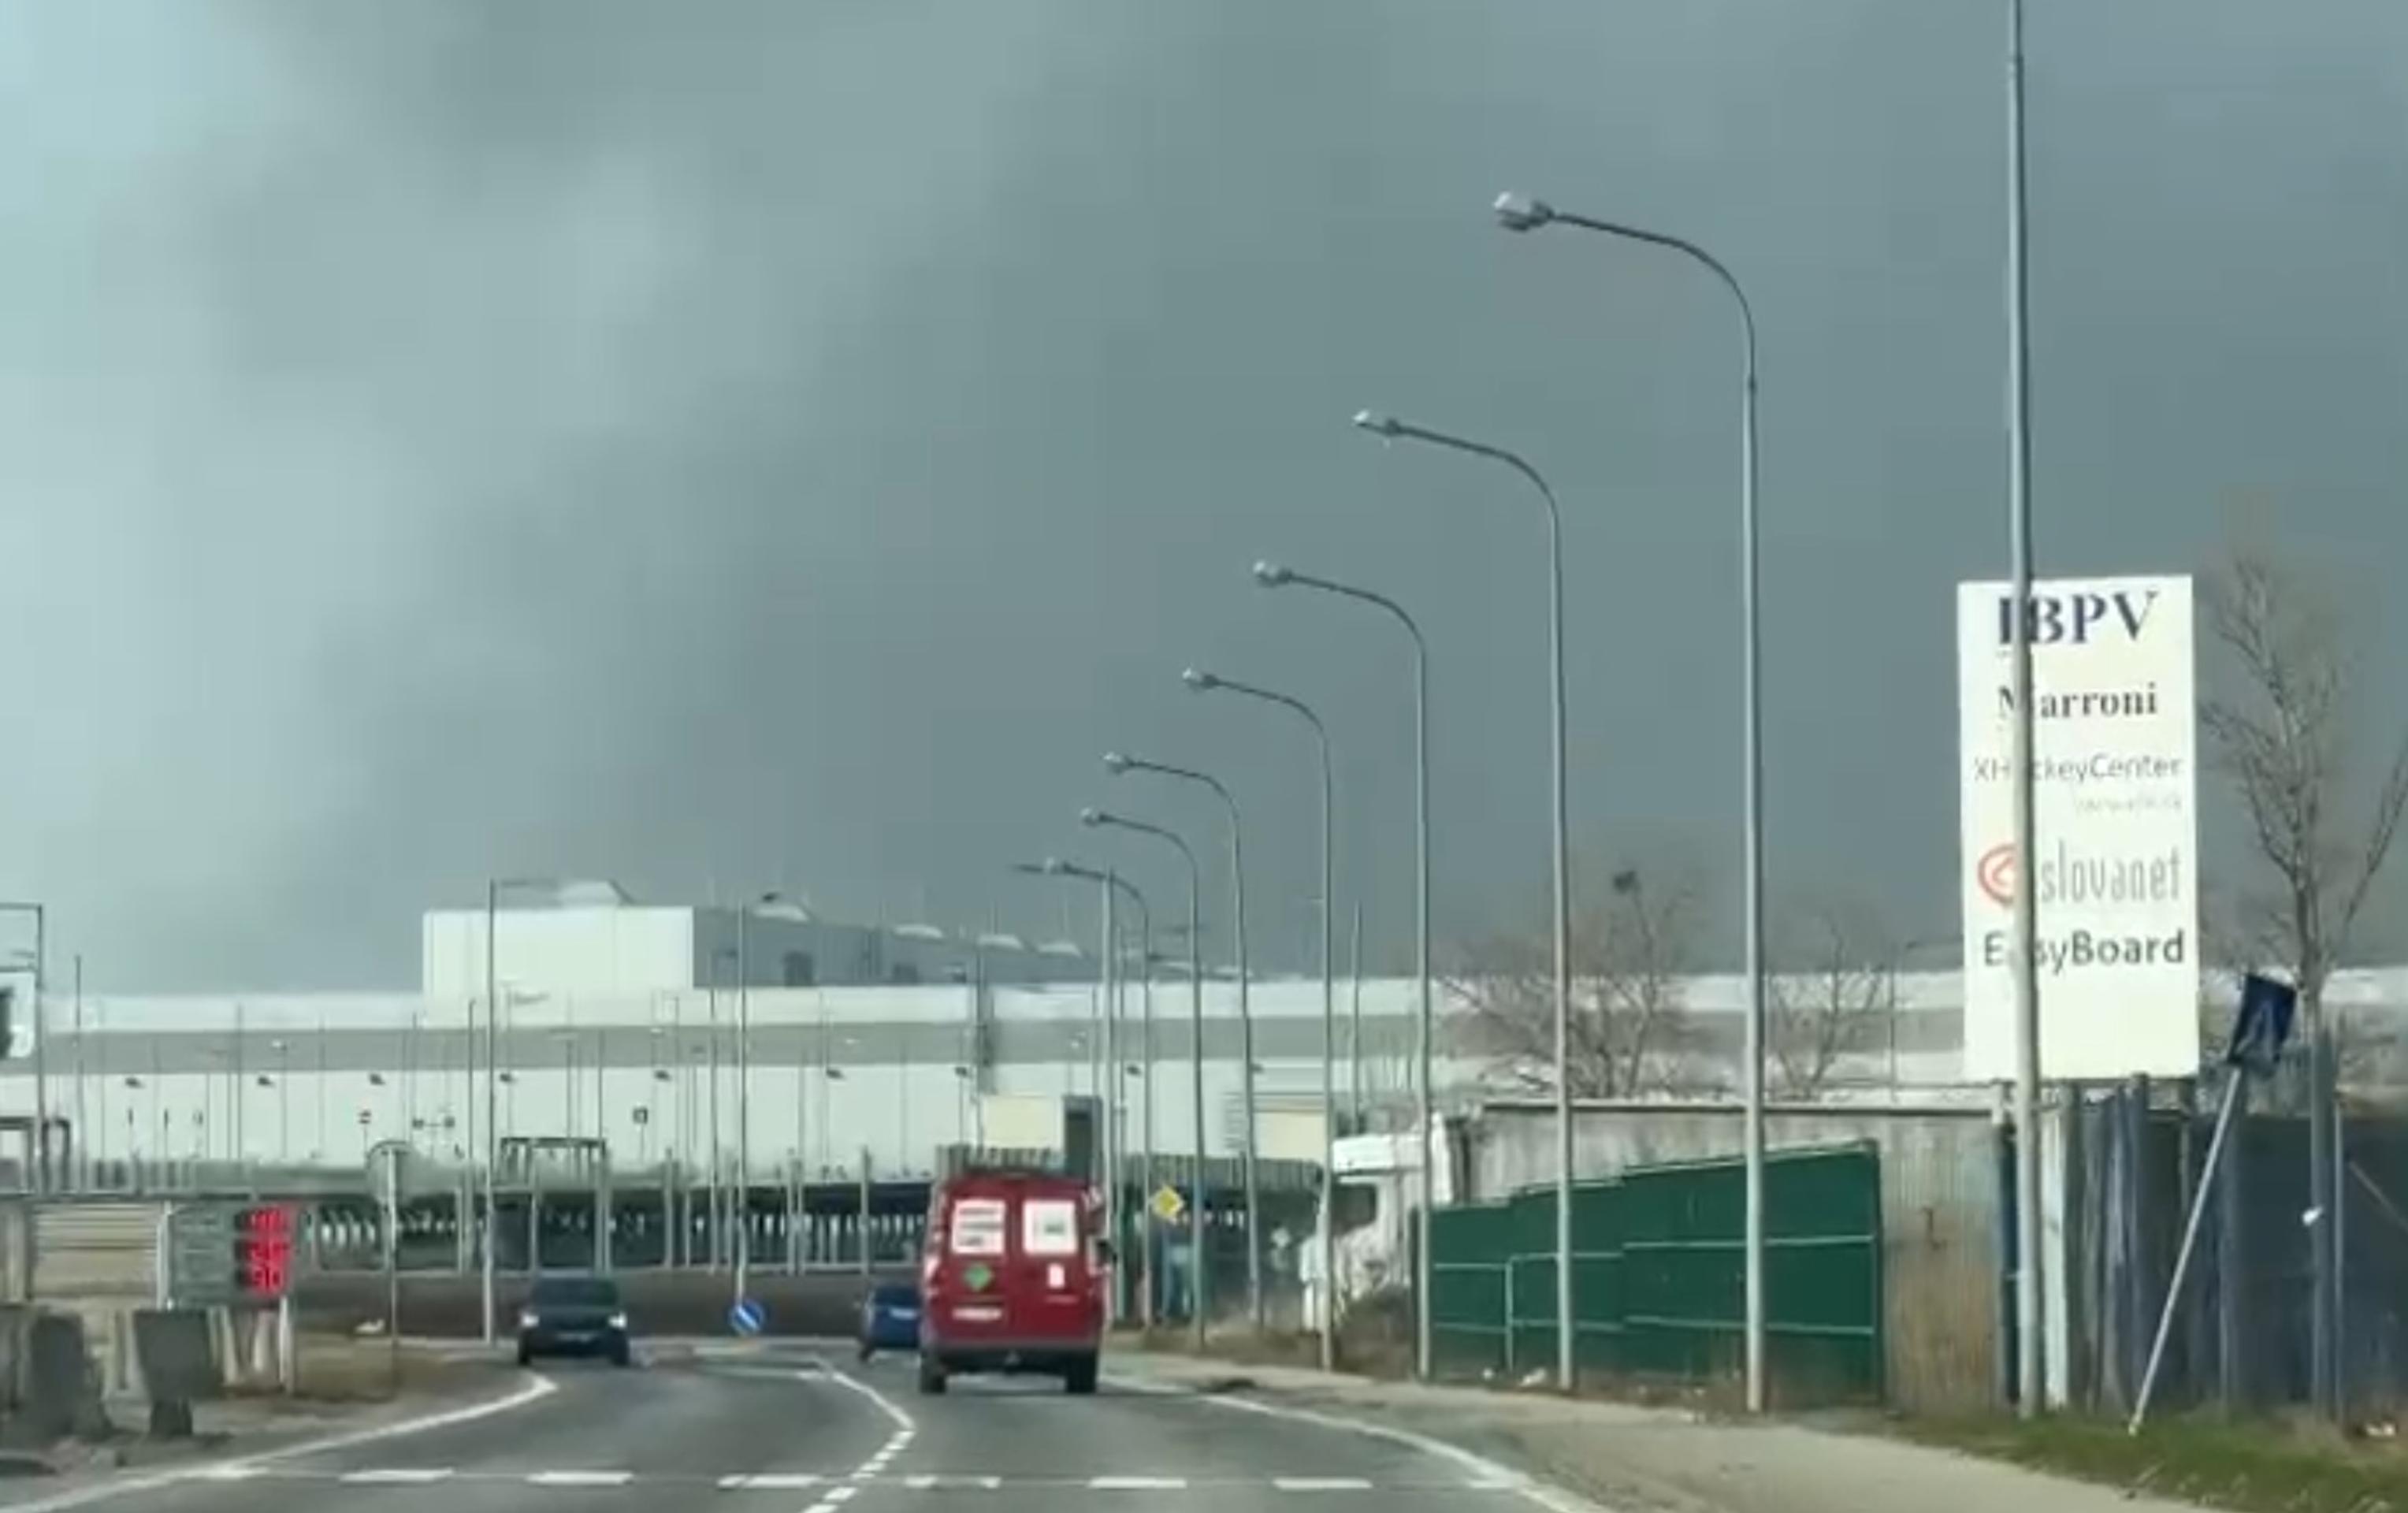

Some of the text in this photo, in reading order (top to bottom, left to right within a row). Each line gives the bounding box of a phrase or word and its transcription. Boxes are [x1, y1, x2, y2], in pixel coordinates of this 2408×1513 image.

[1974, 753, 2181, 782] XHckeyCenter
[2042, 838, 2181, 902] slovanet
[1984, 928, 2183, 976] EsyBoard
